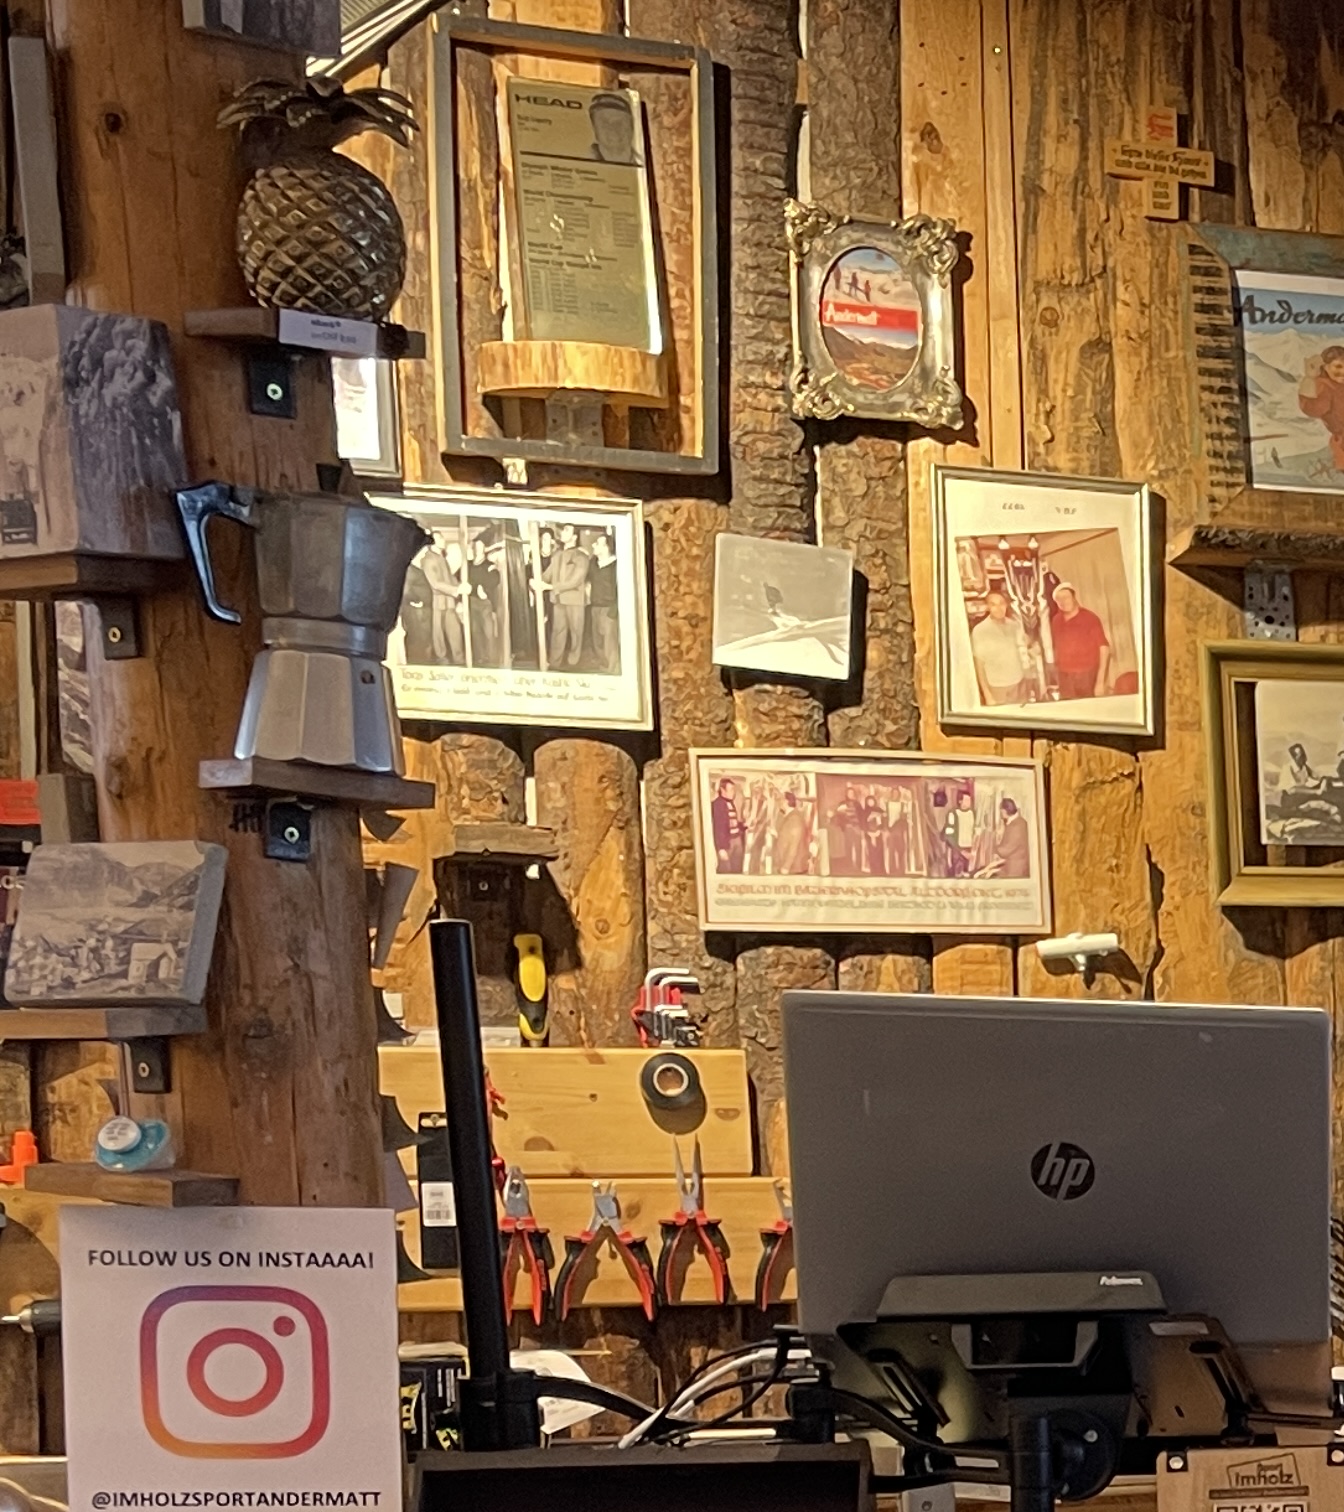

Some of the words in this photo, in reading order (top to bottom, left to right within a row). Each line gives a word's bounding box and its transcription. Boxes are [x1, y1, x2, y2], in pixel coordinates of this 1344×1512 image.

[514, 93, 583, 111] HEAD
[1038, 1147, 1090, 1201] hp
[87, 1249, 178, 1269] FOLLOW
[184, 1250, 213, 1270] US
[218, 1250, 253, 1270] ON
[258, 1250, 375, 1270] INSTAAAA!
[91, 1489, 382, 1511] @IMHOLZSPORTANDERMATT
